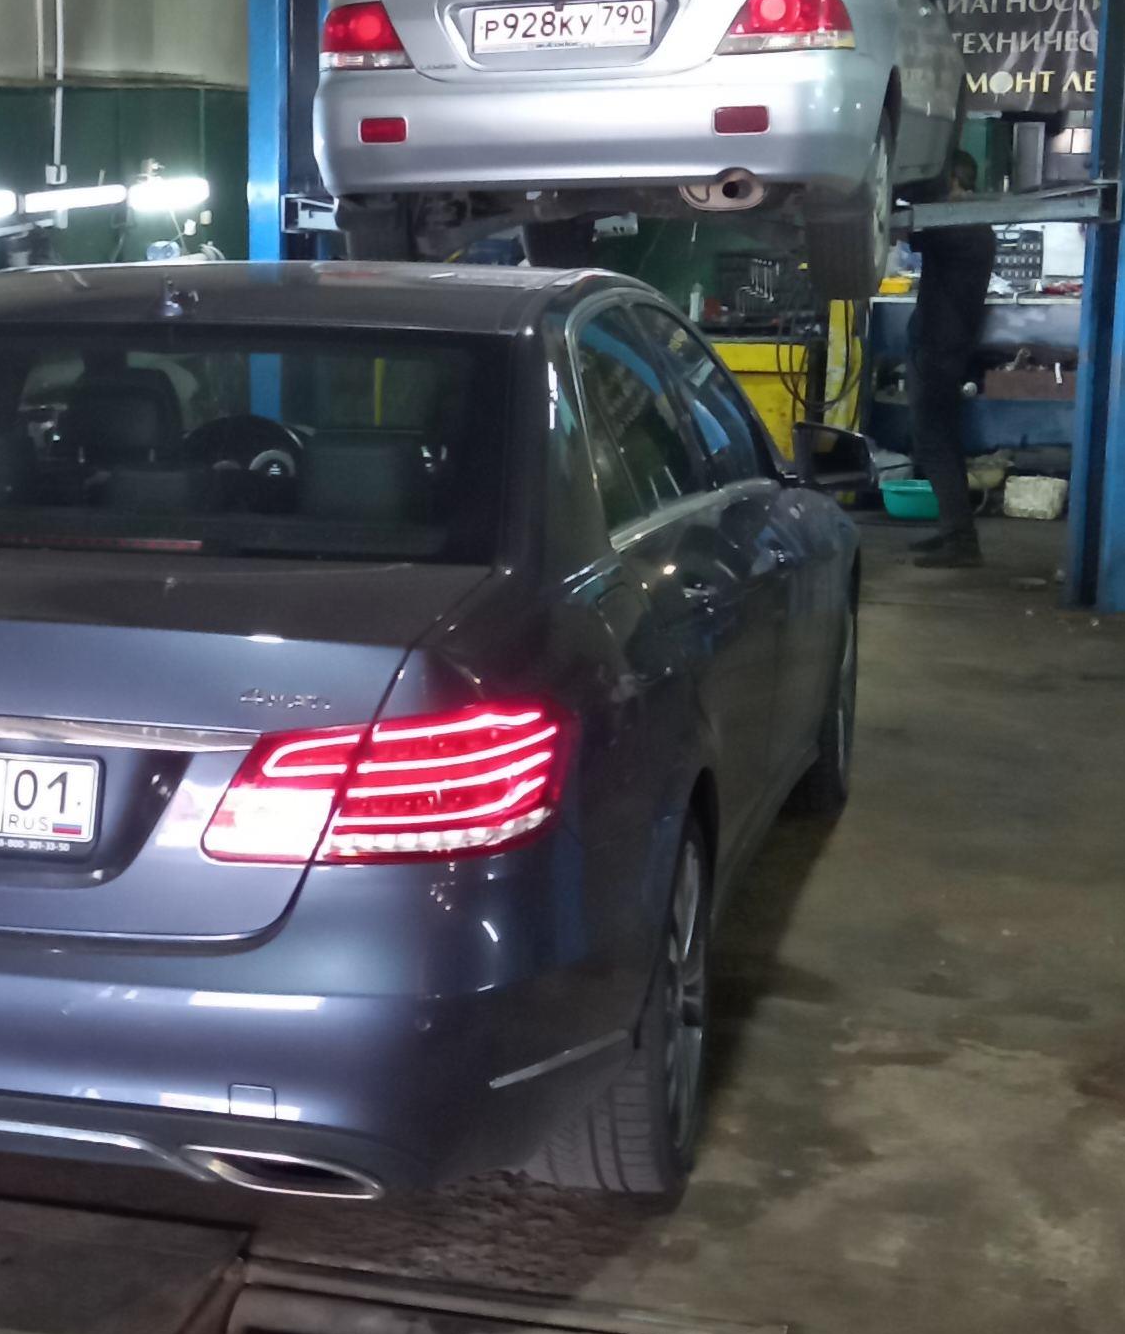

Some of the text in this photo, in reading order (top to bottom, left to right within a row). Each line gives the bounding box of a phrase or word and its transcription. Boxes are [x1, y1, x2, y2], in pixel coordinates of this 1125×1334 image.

[485, 5, 644, 40] Р928КУ 790
[13, 769, 68, 814] 01
[8, 813, 49, 832] RUS
